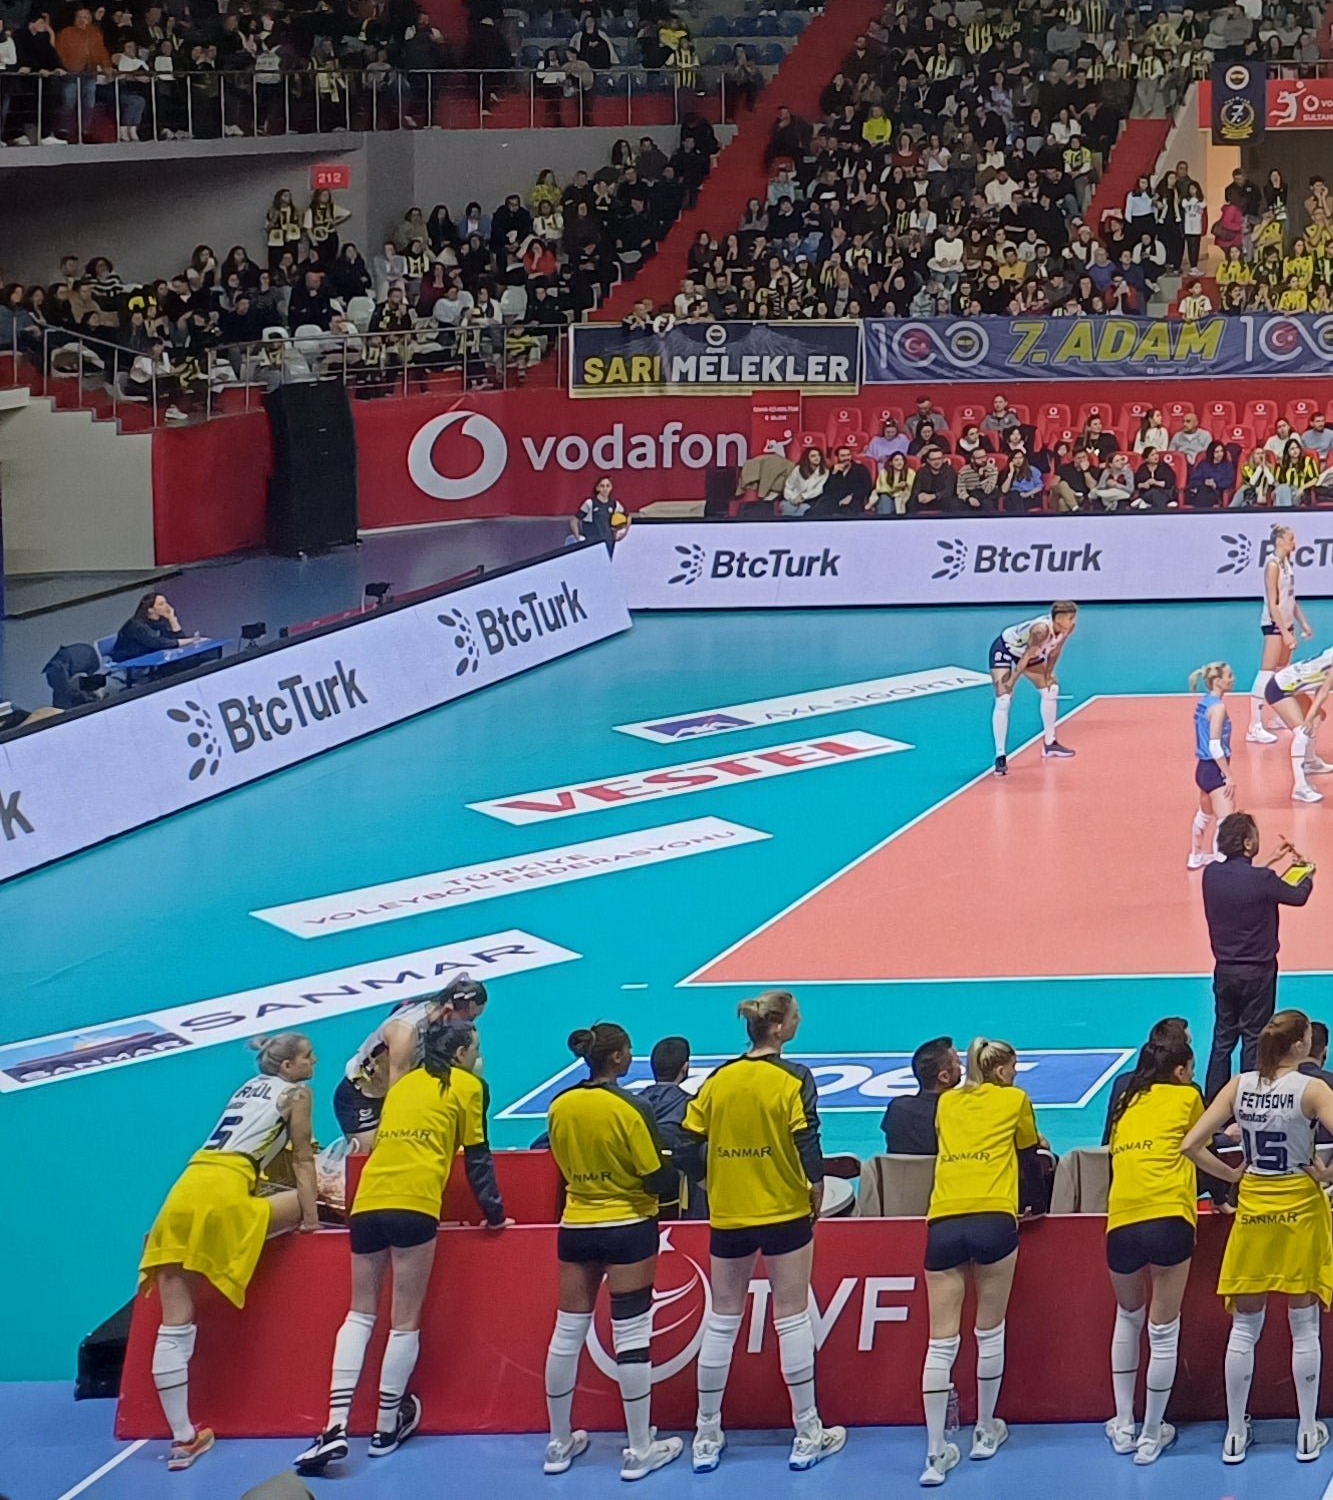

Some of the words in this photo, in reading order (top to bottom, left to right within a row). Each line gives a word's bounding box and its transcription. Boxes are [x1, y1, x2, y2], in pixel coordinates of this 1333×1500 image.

[318, 172, 341, 183] 212
[584, 356, 661, 384] SARI
[672, 355, 850, 382] MELEKLER
[522, 421, 748, 470] vodafon
[711, 547, 840, 581] BtcTurk
[973, 542, 1102, 574] BtcTurk
[476, 581, 589, 656] BtcTurk
[218, 660, 369, 757] BtcTurk
[765, 703, 831, 720] AXA
[496, 733, 890, 815] VESTEL
[303, 883, 498, 925] VOLEYBOL
[504, 830, 738, 883] FEDERASYONU
[445, 852, 589, 886] TÜRKİYE
[179, 943, 539, 1033] SANMAR
[20, 1039, 190, 1083] SANMAR
[1240, 1091, 1295, 1109] FETISOVA
[1241, 1127, 1288, 1172] 15
[1240, 1211, 1298, 1225] SANMAR
